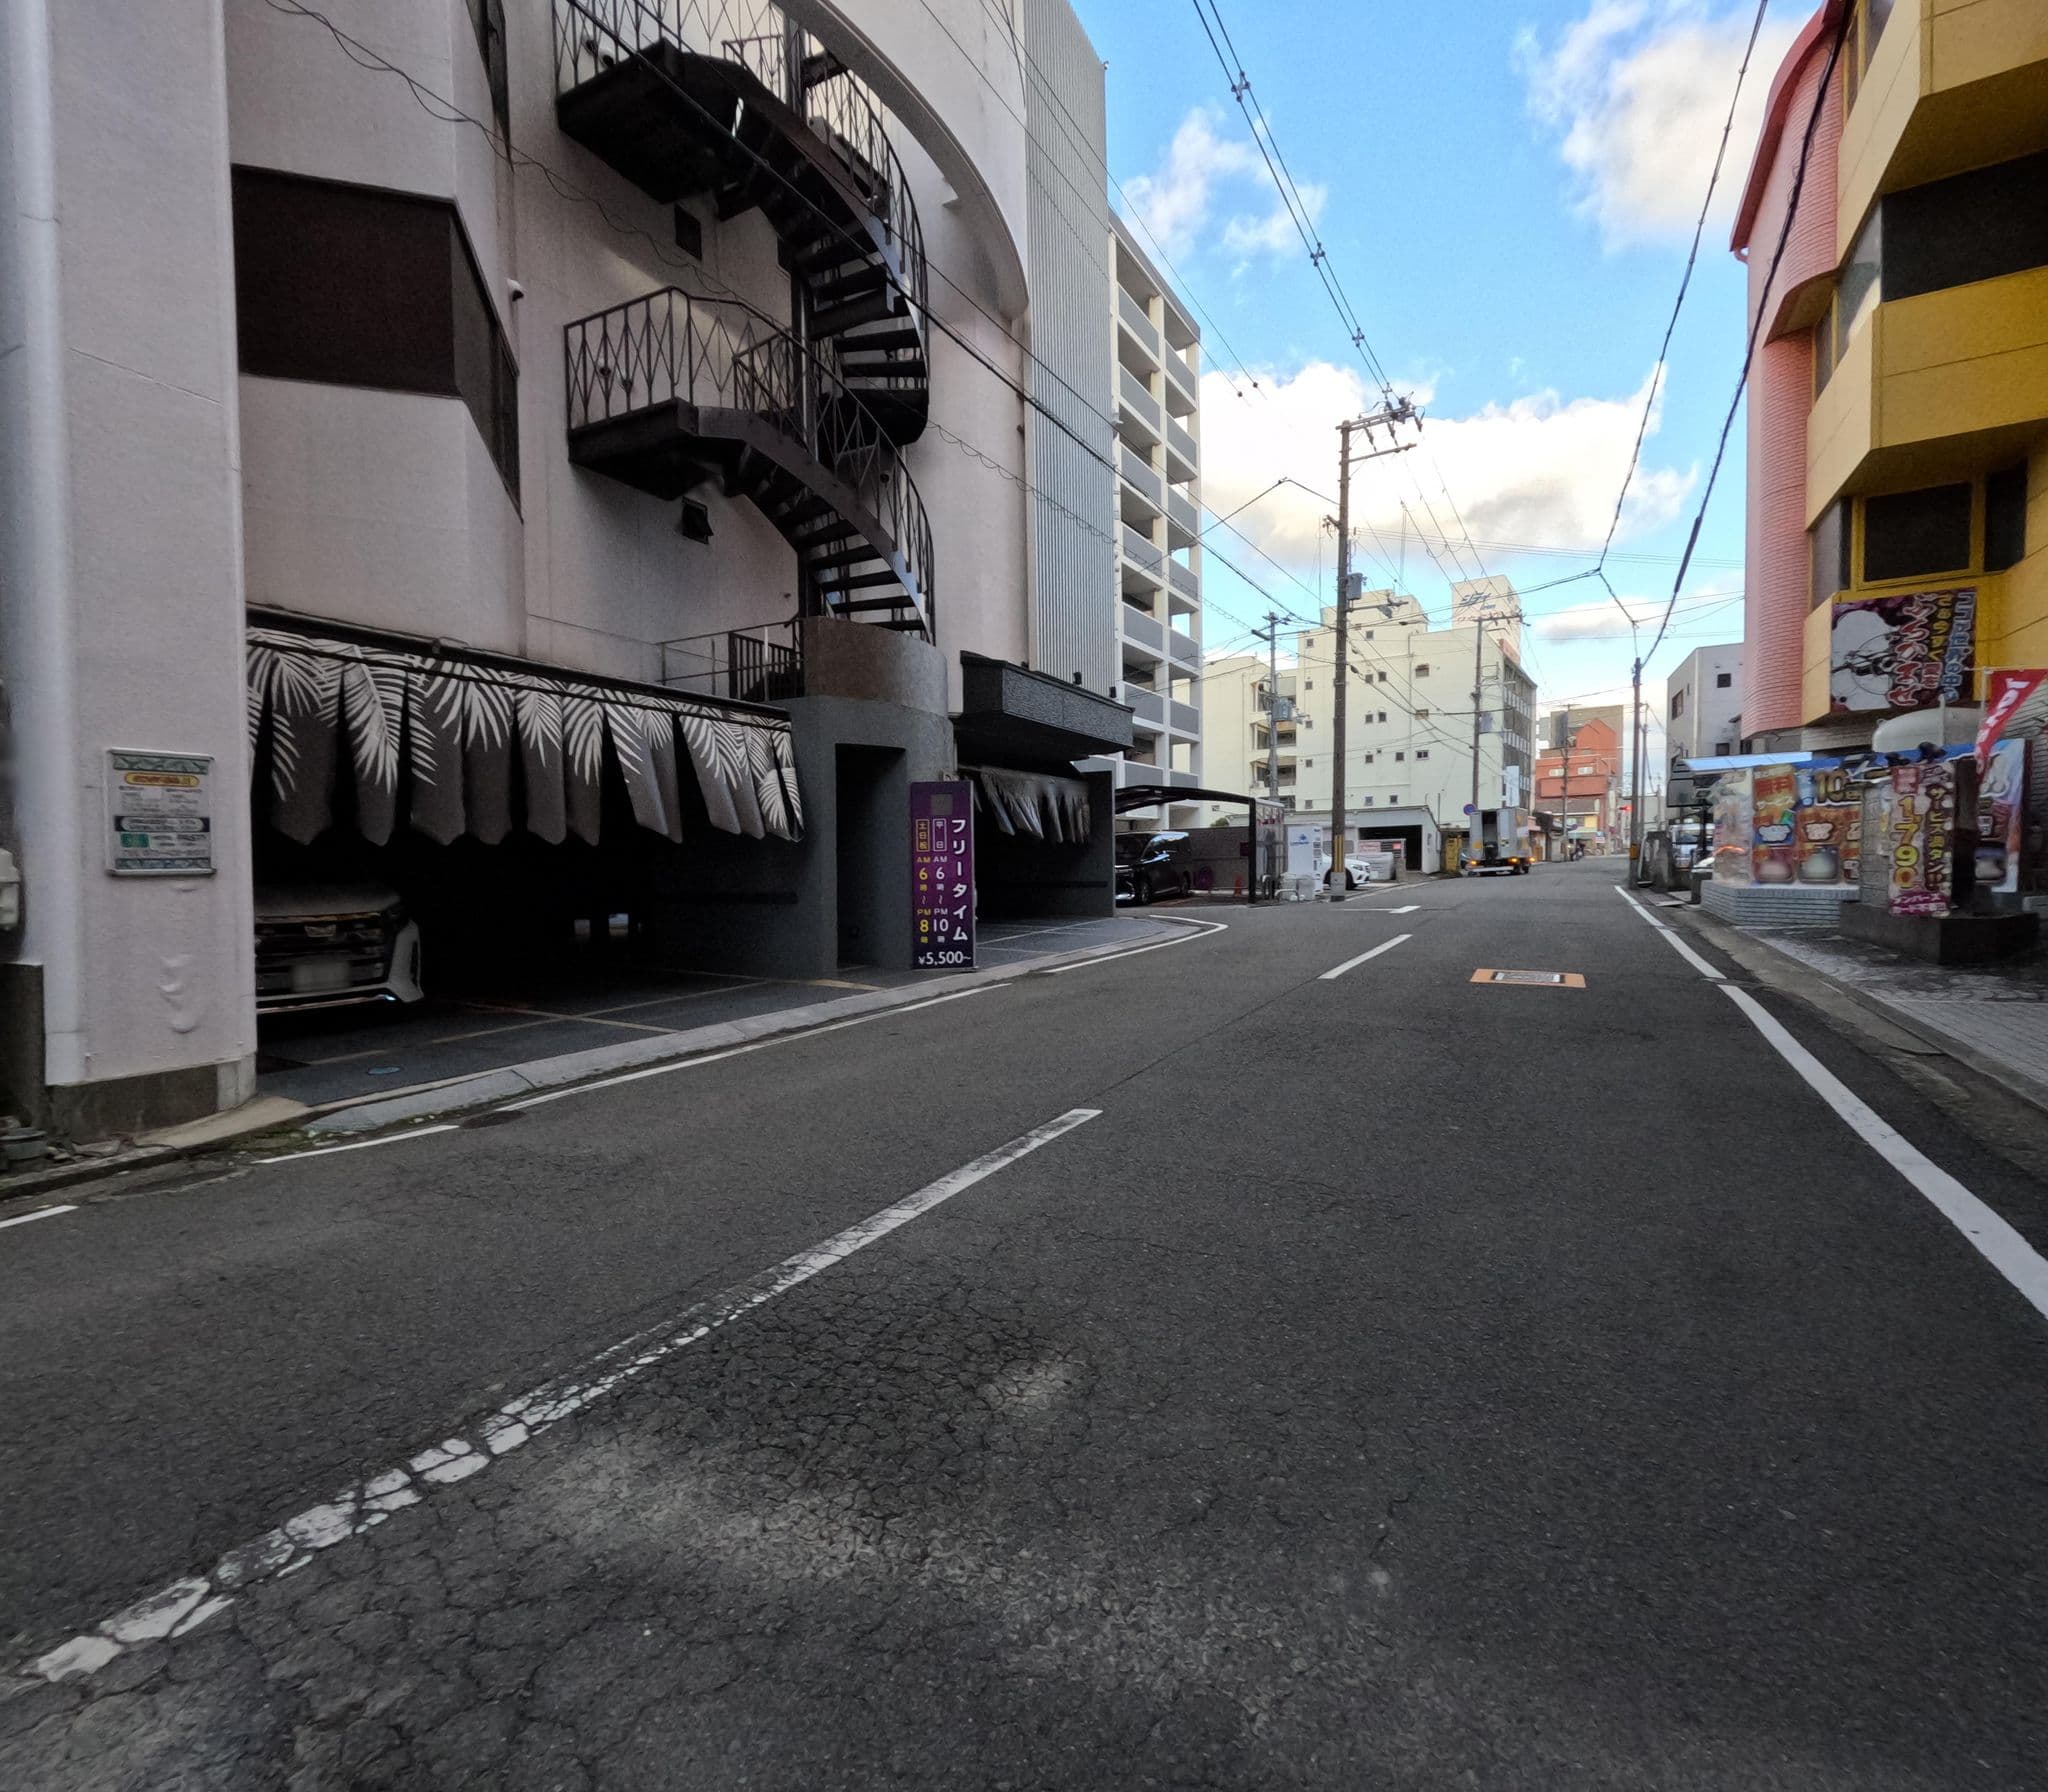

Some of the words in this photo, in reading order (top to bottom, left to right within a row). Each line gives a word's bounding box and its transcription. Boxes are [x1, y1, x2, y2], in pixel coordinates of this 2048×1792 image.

[952, 819, 968, 941] フリータイム
